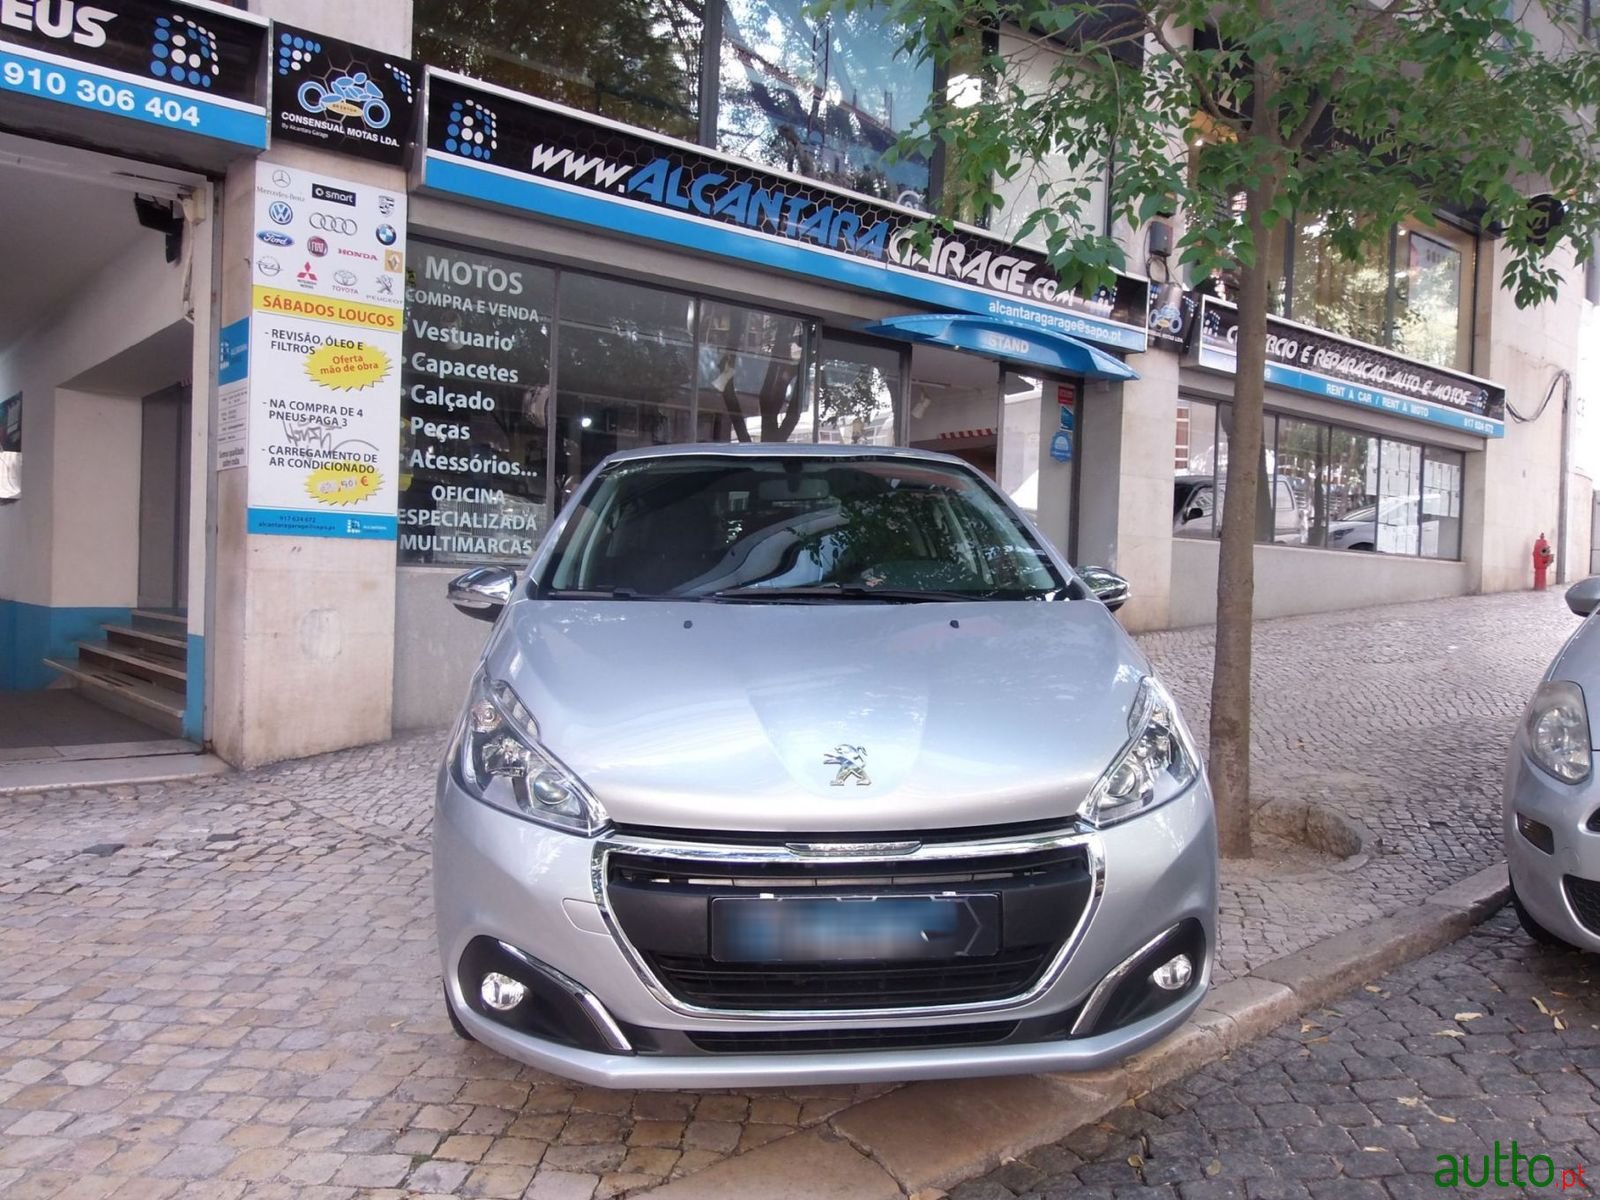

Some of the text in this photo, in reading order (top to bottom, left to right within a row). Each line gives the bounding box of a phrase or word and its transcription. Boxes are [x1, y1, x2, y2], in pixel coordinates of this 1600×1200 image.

[0, 0, 118, 48] EUS
[4, 61, 200, 127] 910 306 404
[281, 111, 400, 147] CONSENSUAL MOTAS LDA.
[325, 188, 354, 205] smart
[263, 232, 288, 245] Ford
[338, 248, 378, 261] HONDA
[425, 256, 523, 295] MOTOS
[332, 285, 358, 295] TOYOTA
[263, 294, 395, 328] SÁBADOS LOUCOS
[406, 288, 539, 323] COMPRA E VENDA
[988, 300, 1121, 343] alcantaragarage@sapo.pt
[325, 335, 355, 350] ÓLEO
[357, 342, 364, 350] E
[412, 319, 513, 351] Vestuario
[990, 334, 1029, 353] STAND
[271, 341, 316, 355] FILTROS
[320, 361, 379, 375] mão de obra
[332, 354, 363, 365] Oferta
[411, 351, 519, 383] Capacetes
[1300, 345, 1314, 364] E
[1432, 384, 1472, 406] MOTOS
[410, 384, 495, 412] Calçado
[1326, 383, 1345, 397] RENT
[1348, 389, 1354, 399] A
[1357, 391, 1372, 403] CAR
[1382, 397, 1400, 410] RENT
[269, 398, 363, 417] NA COMPRA DE 4
[269, 410, 348, 427] PNEUS PAGA 3
[410, 416, 471, 443] Peças
[268, 444, 378, 463] CARREGAMENTO DE
[409, 448, 538, 477] Acessórios...
[269, 456, 375, 473] AR CONDICIONADO
[431, 485, 506, 504] OFICINA
[398, 508, 537, 530] ESPECIALIZADA
[400, 533, 532, 554] MULTIMARCAS
